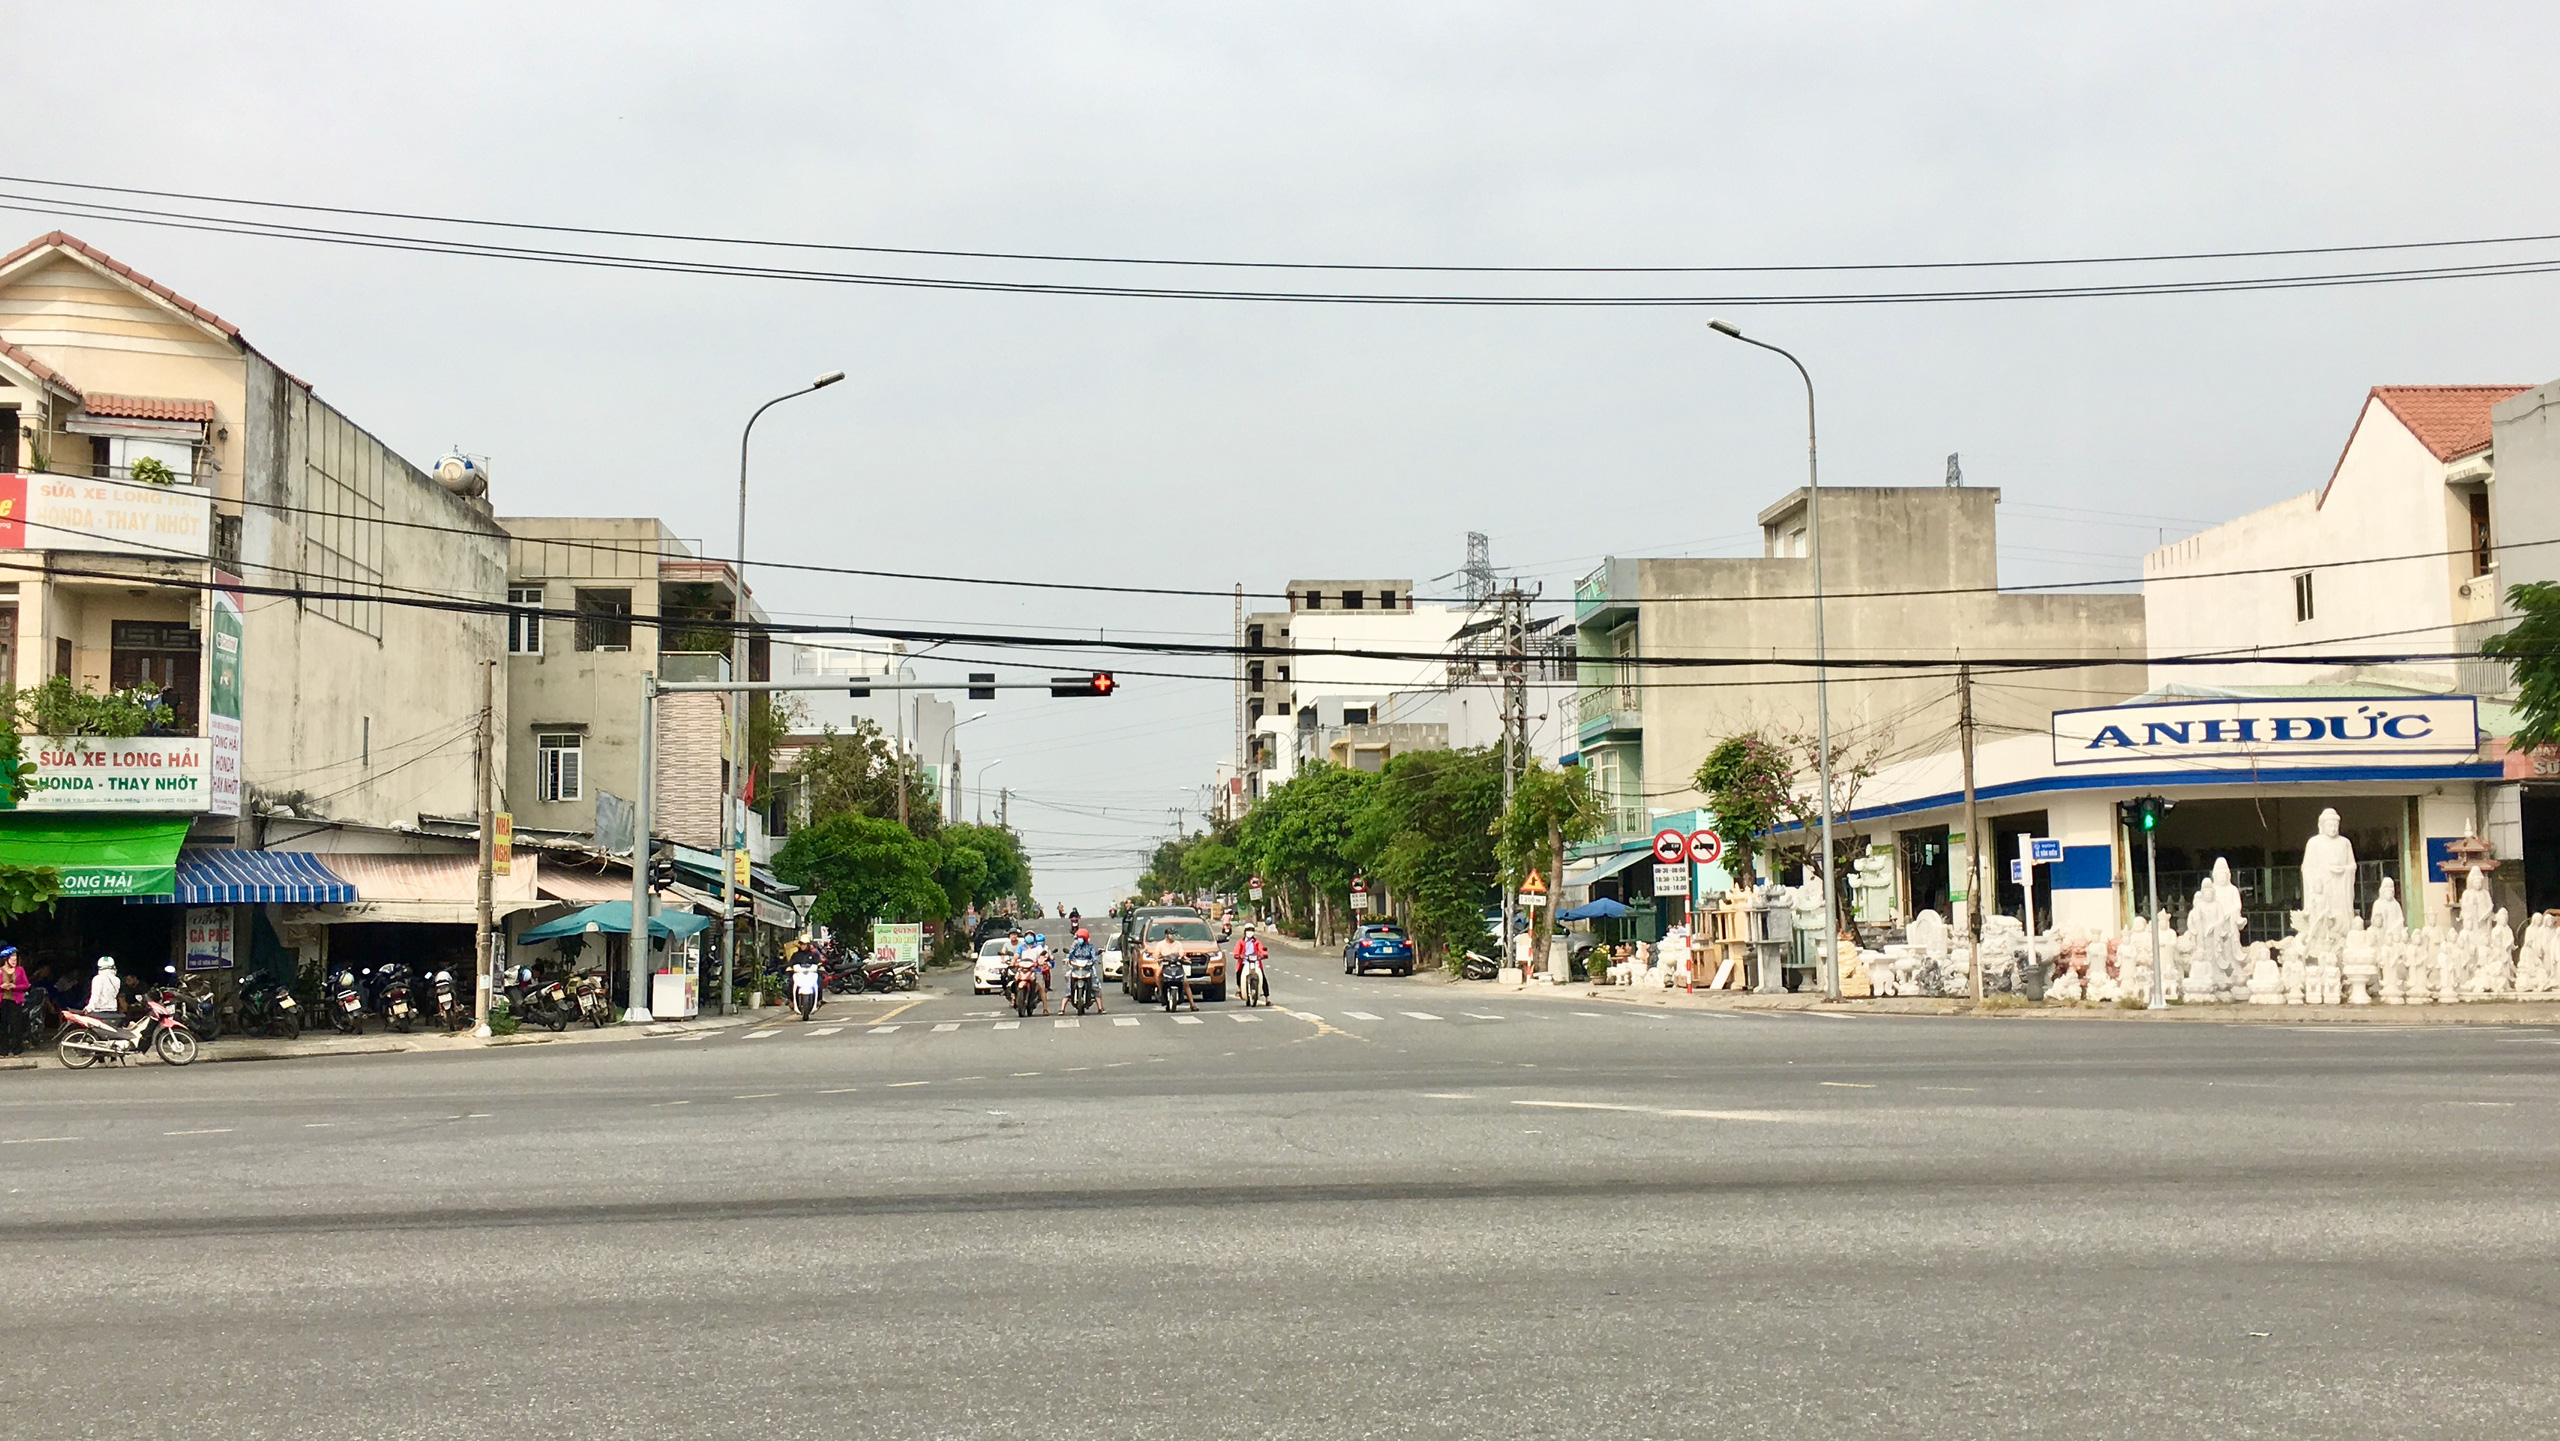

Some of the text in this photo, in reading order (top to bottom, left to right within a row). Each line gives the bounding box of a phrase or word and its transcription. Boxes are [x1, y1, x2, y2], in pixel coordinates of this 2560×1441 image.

[83, 487, 107, 500] XE
[113, 489, 162, 505] LONG
[37, 505, 94, 528] HONDA
[105, 510, 149, 531] THAY
[2085, 705, 2434, 749] ANH ĐỨC
[83, 751, 106, 767] XE
[113, 751, 162, 767] LONG
[168, 747, 199, 767] HẢI
[216, 755, 234, 772] HONDA
[39, 776, 94, 790] HONDA
[108, 777, 150, 790] THAY
[155, 773, 198, 791] NHỚT
[496, 814, 509, 836] NHÀ
[104, 871, 133, 888] HẢI
